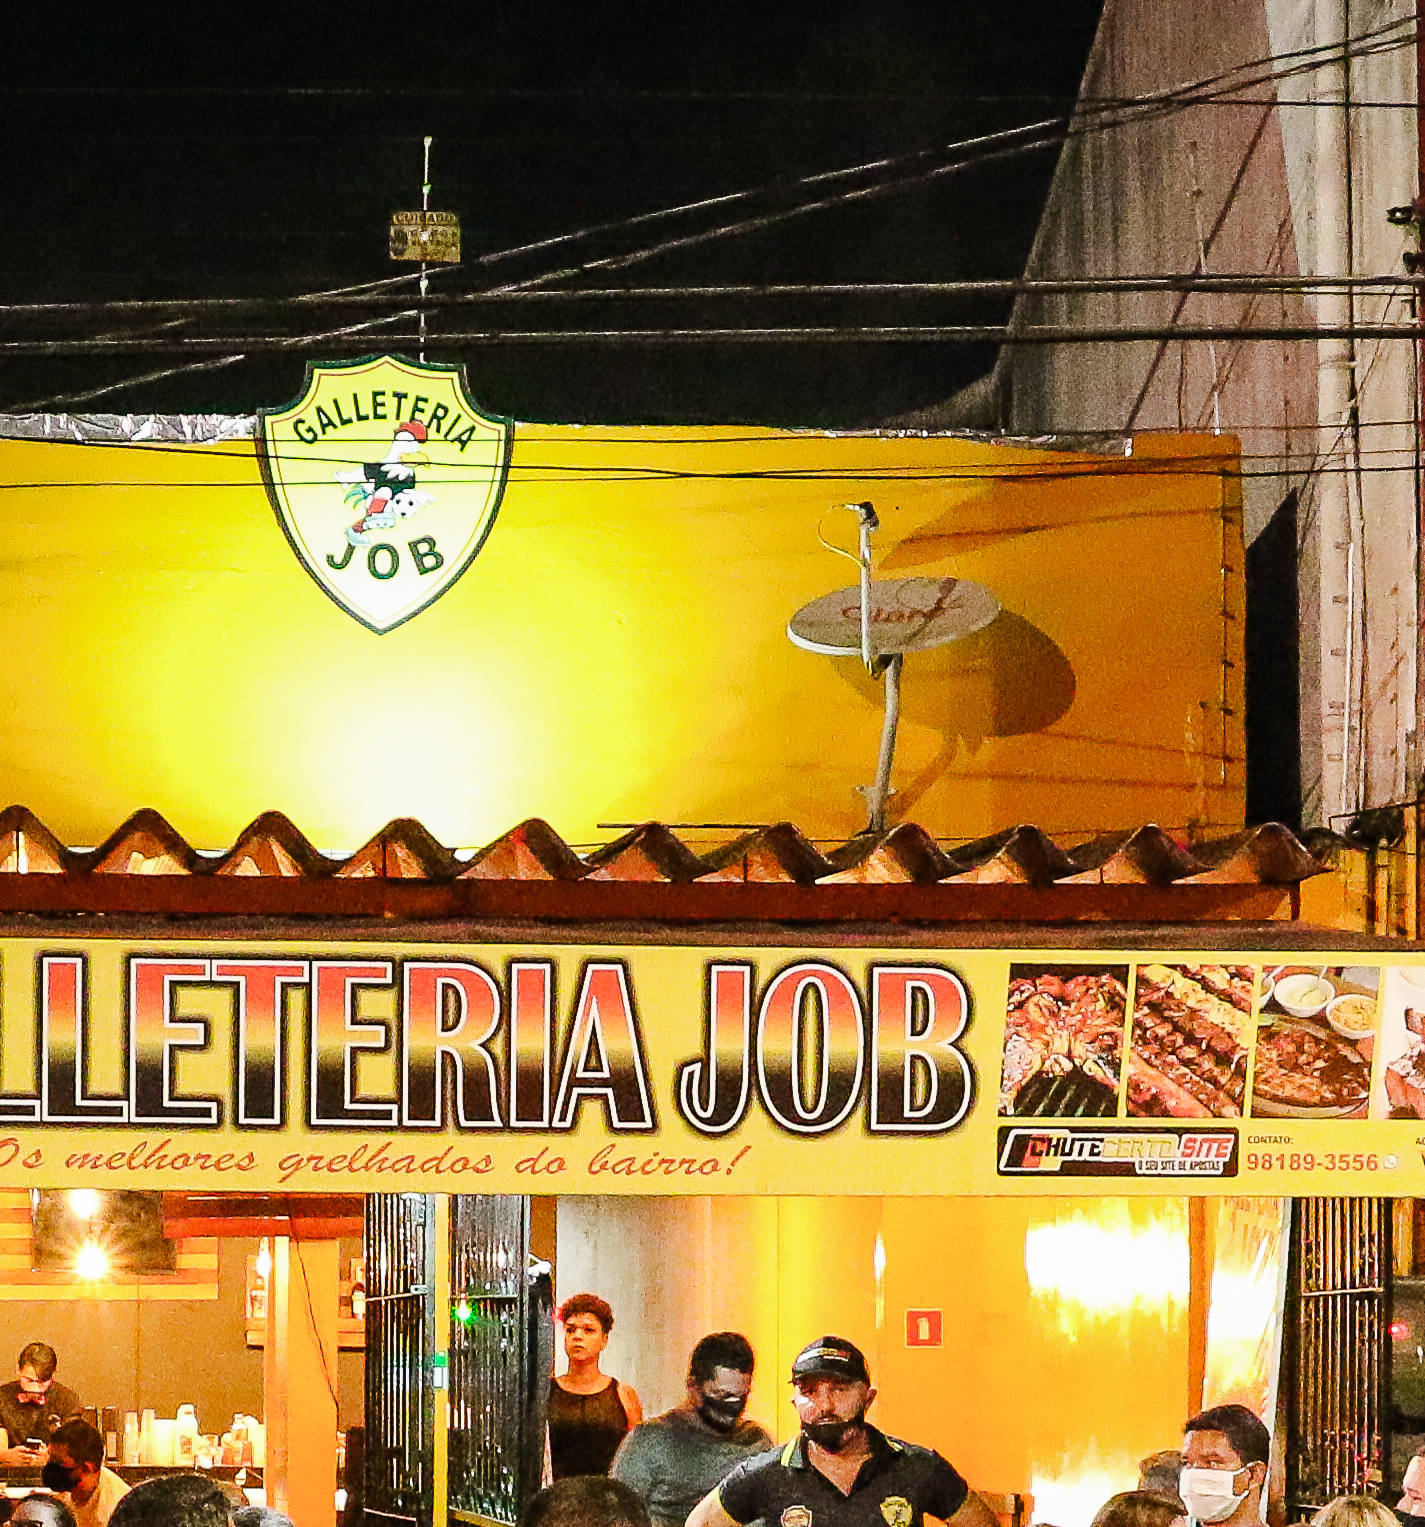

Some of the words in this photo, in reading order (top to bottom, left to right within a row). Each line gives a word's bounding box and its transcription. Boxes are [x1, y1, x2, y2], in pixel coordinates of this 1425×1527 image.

[292, 391, 477, 452] GALLETERIA
[326, 535, 444, 580] JOB
[675, 957, 978, 1138] JOB
[64, 1141, 255, 1172] melhores
[277, 1144, 494, 1182] grelhados
[513, 1148, 568, 1177] do
[587, 1145, 753, 1178] bairro!
[1247, 1135, 1294, 1145] CONTATO:
[1247, 1153, 1379, 1172] 98189-3556
